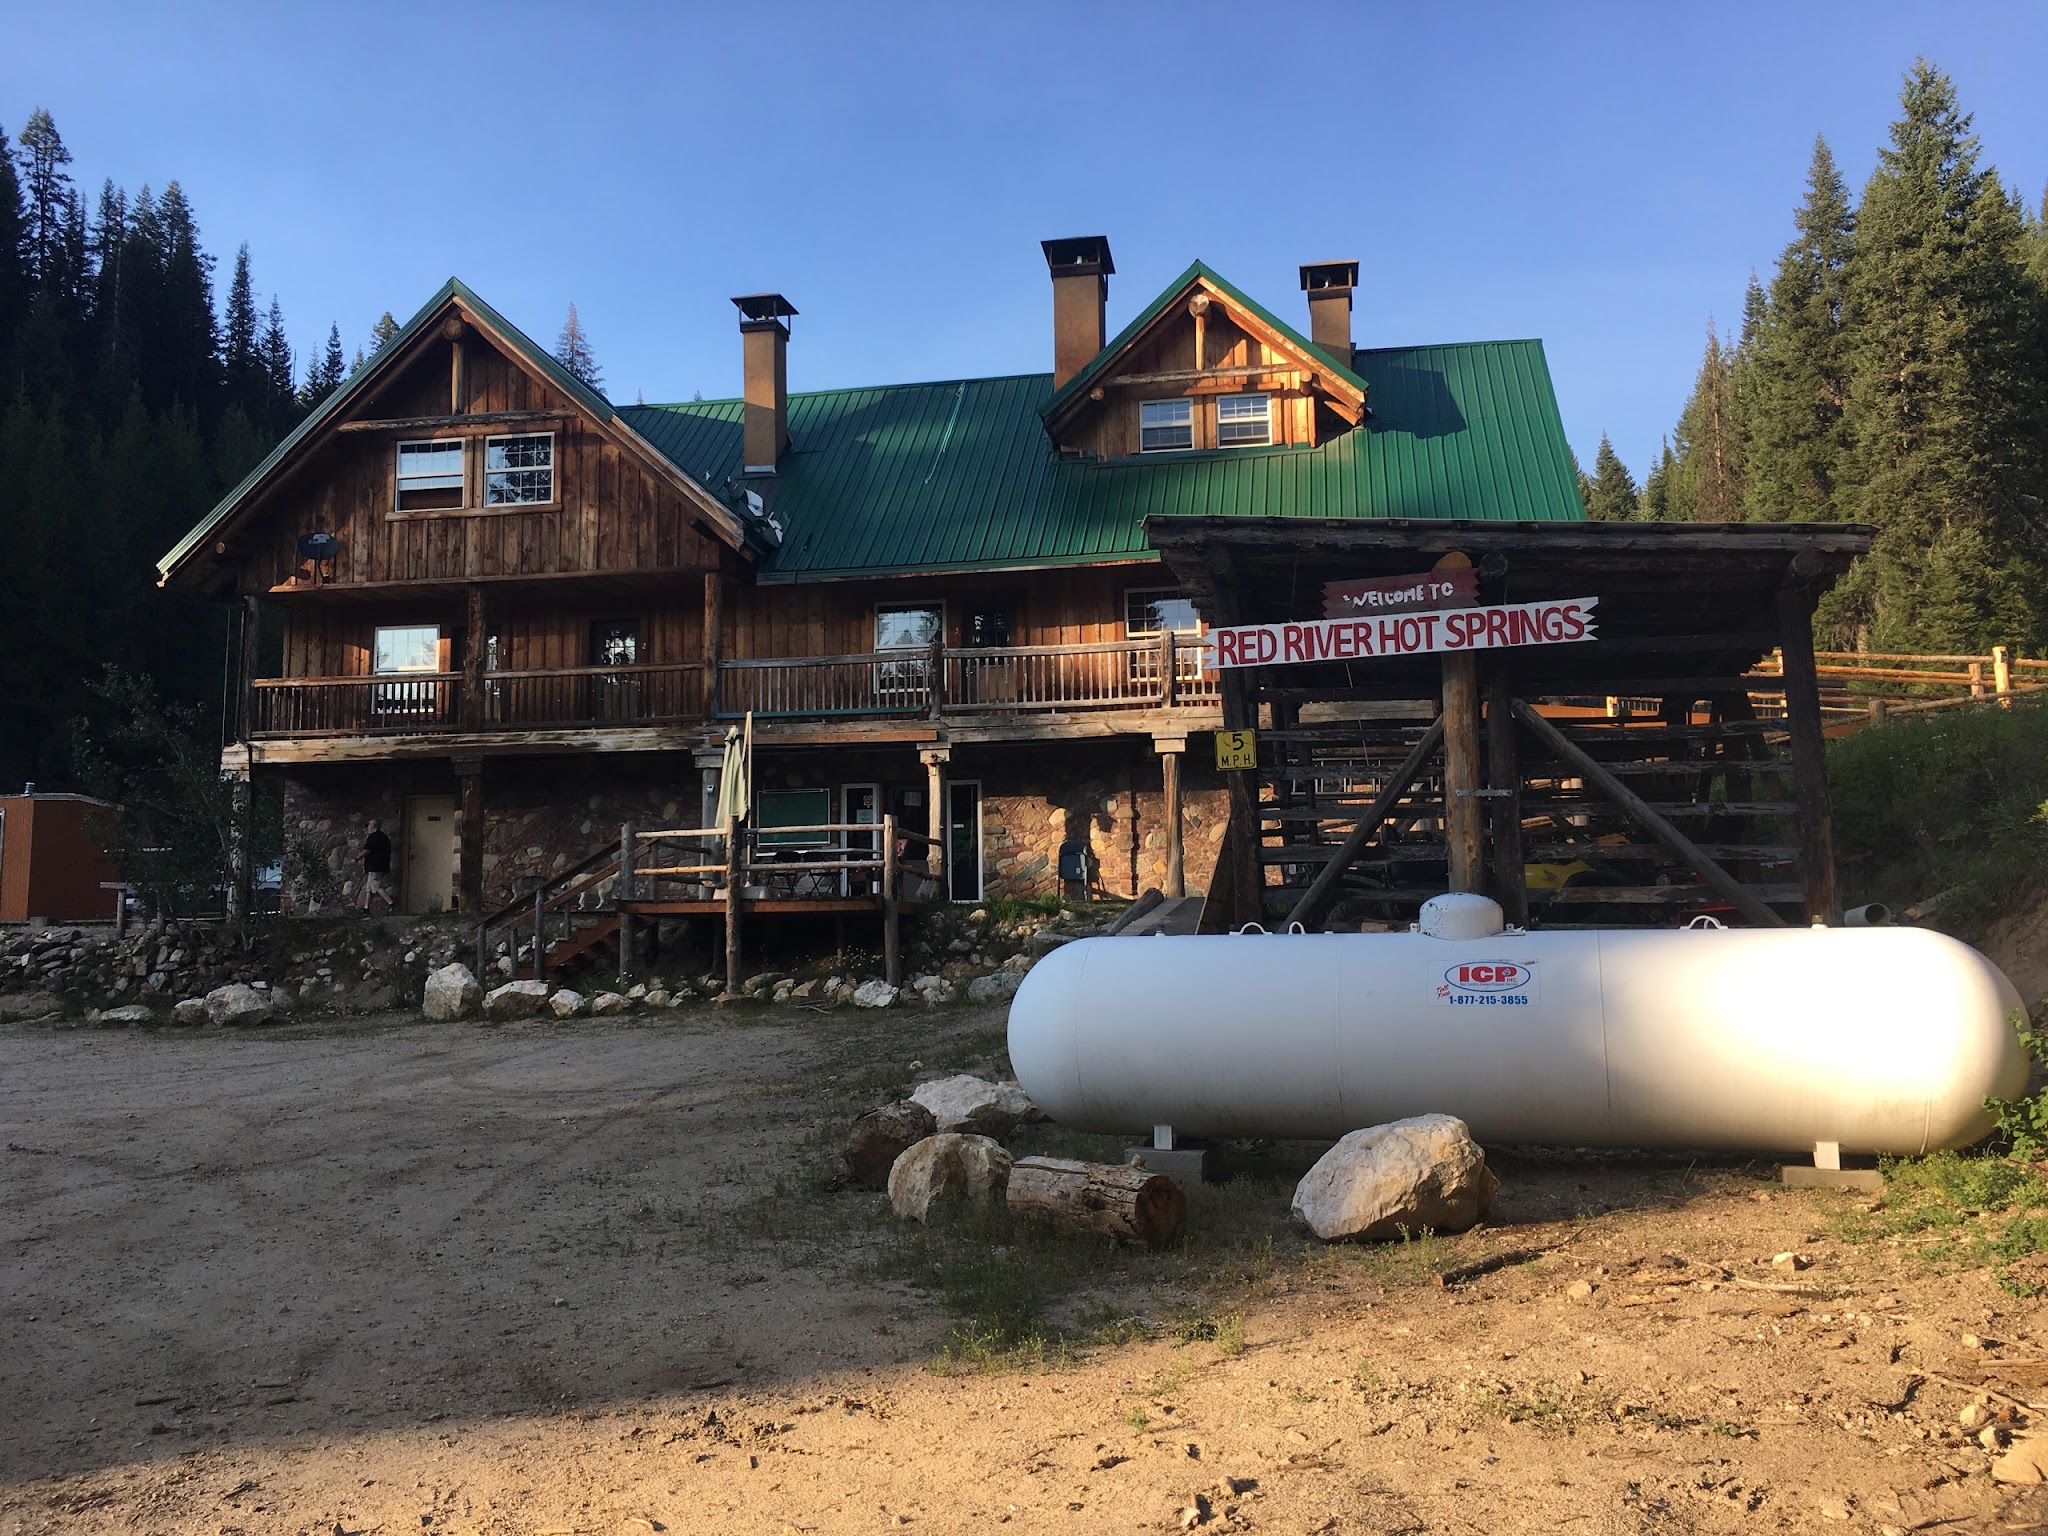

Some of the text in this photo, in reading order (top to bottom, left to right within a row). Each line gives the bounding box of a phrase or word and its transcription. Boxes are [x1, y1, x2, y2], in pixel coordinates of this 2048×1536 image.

[1218, 604, 1585, 665] RED RIVER HOT SPRINGS
[1232, 733, 1244, 751] 5
[1459, 966, 1518, 983] ICP
[1449, 995, 1528, 1005] 1-877-215-3855
